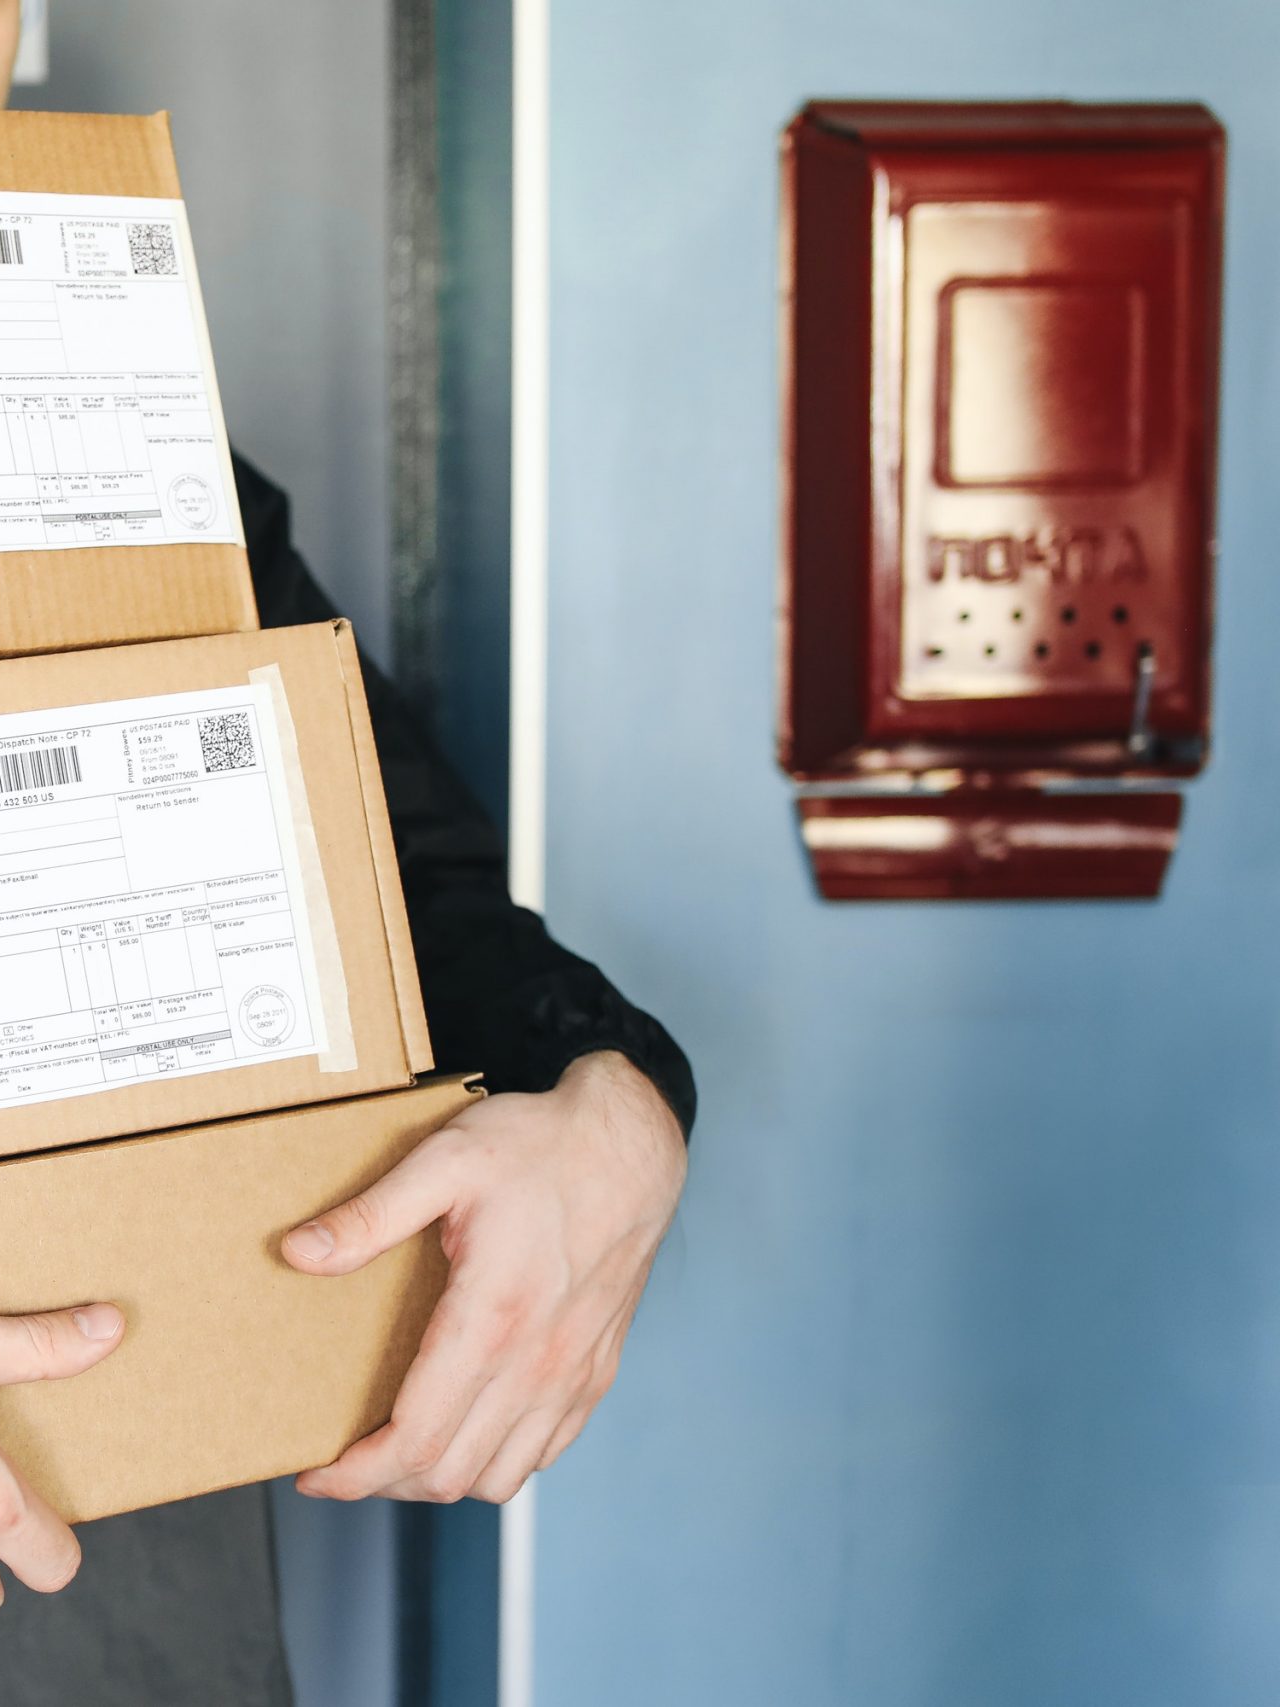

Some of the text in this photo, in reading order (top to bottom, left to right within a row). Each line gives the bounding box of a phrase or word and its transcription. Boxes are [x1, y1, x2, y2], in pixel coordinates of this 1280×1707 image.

[10, 216, 21, 224] CP
[925, 526, 1149, 586] ПОЧТА
[139, 721, 172, 731] POSTAGE
[174, 719, 190, 727] PAID
[38, 734, 58, 744] Note
[66, 730, 78, 740] CP
[81, 729, 91, 738] 72
[122, 729, 130, 756] Bowes
[4, 798, 20, 807] 432
[22, 795, 38, 804] 503
[41, 792, 54, 802] US
[118, 786, 191, 802] Nondelivery Instructions
[136, 797, 199, 811] Return to Sender
[210, 902, 233, 910] Insured
[235, 898, 258, 906] Amount
[182, 908, 207, 917] Country
[80, 924, 102, 933] Weight
[218, 950, 240, 958] Mailing
[241, 946, 259, 954] Office
[158, 997, 183, 1005] Postage
[136, 1037, 194, 1052] POSTAL USE ONLY
